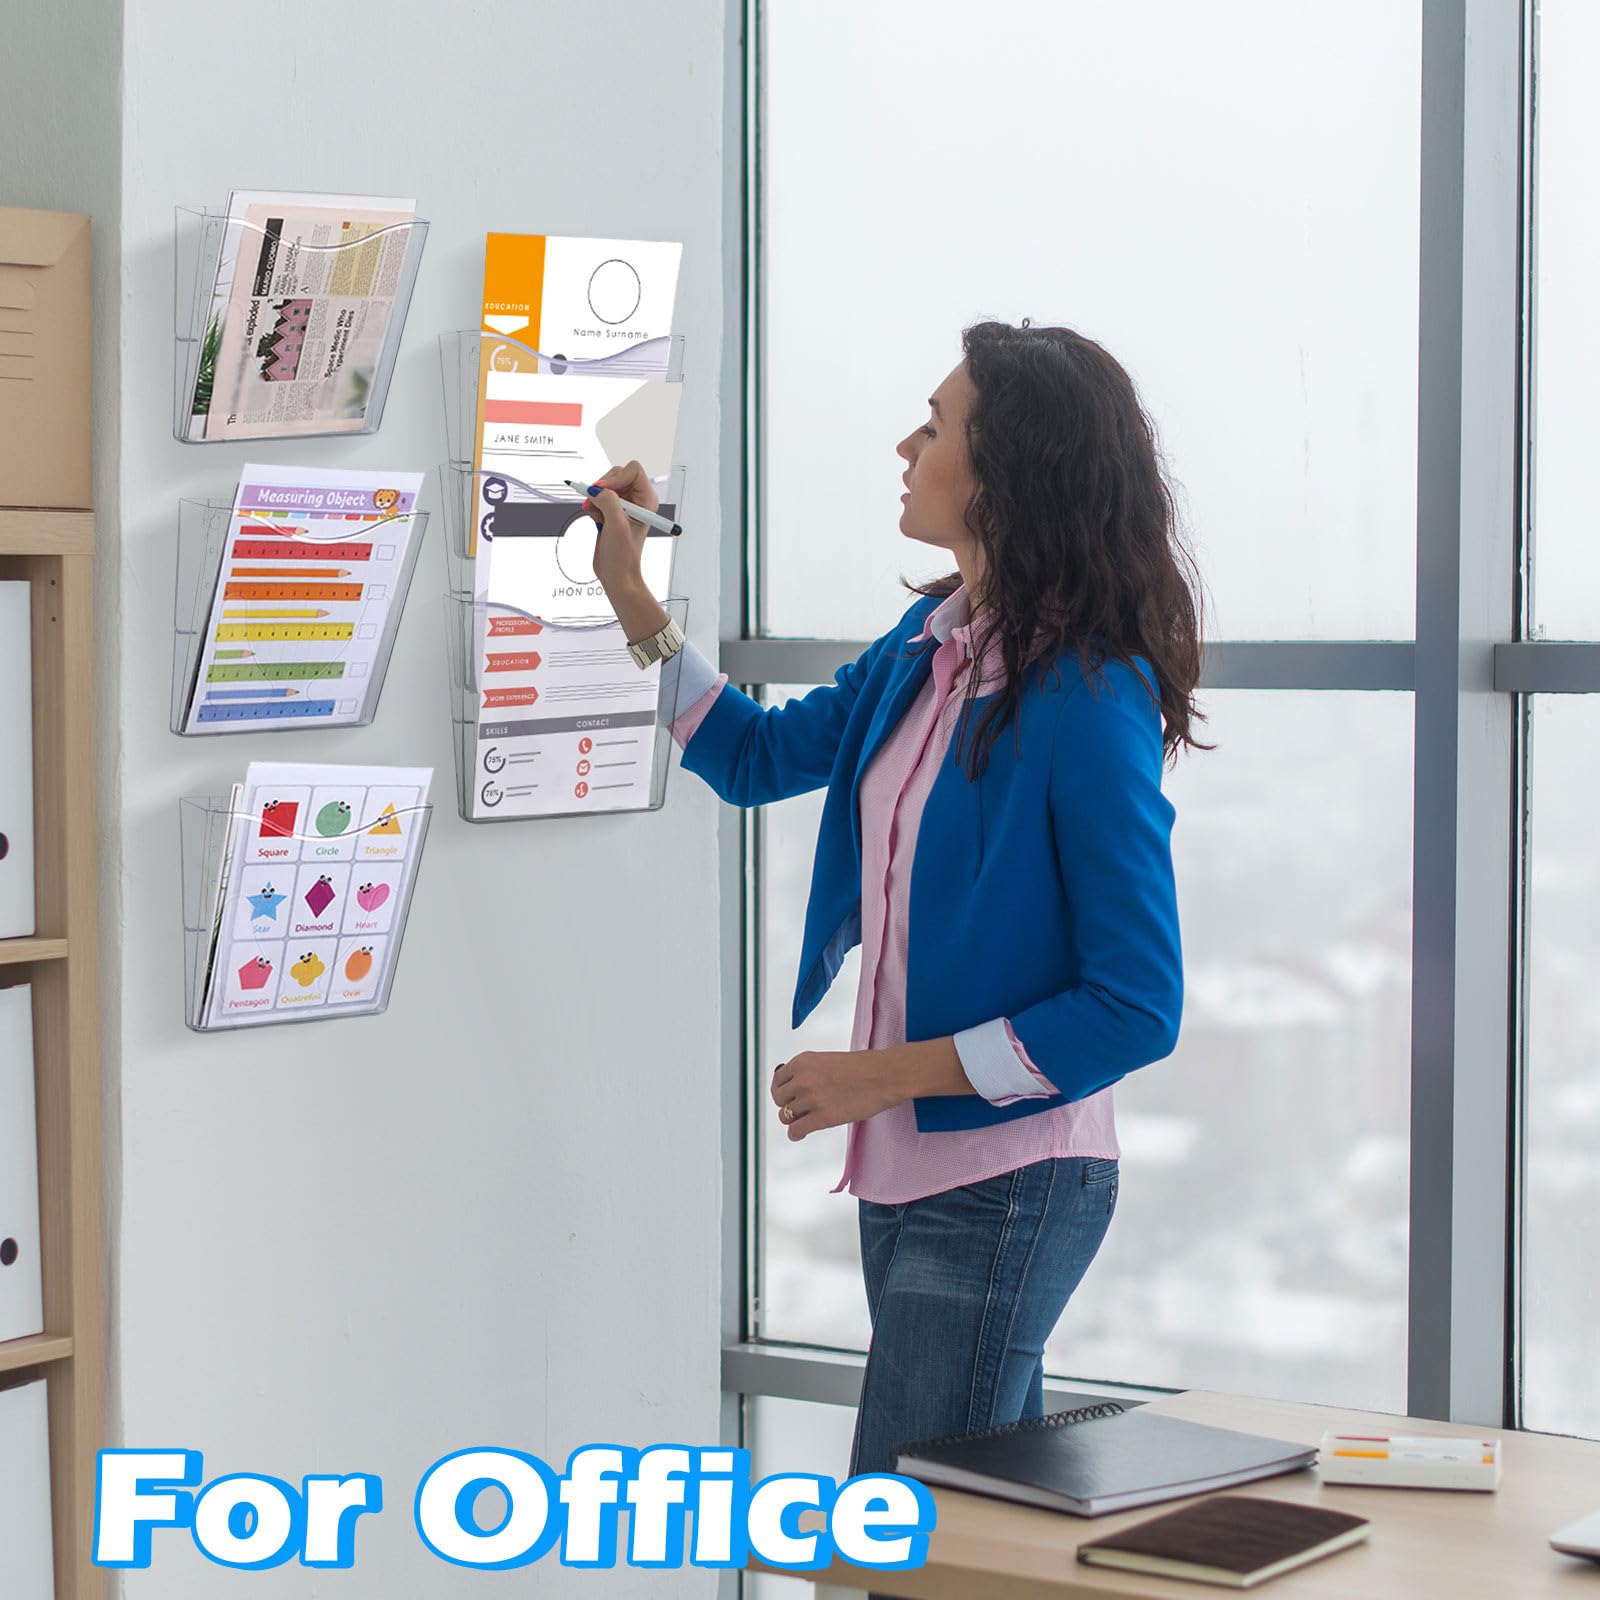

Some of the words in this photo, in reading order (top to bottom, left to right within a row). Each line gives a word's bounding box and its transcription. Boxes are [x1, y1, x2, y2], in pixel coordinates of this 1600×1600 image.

[266, 240, 278, 270] CUOMO
[261, 270, 272, 295] MARIO
[485, 302, 530, 312] EDUCATION
[246, 300, 260, 336] exploded
[336, 309, 347, 328] Who
[344, 310, 355, 328] Dies
[572, 328, 602, 338] Name
[605, 330, 649, 340] Surname
[330, 328, 343, 352] Medic
[324, 353, 336, 377] Space
[493, 434, 520, 444] JANE
[524, 435, 555, 446] SMITH
[257, 489, 324, 508] Measuring
[326, 491, 367, 507] Object
[552, 586, 583, 598] JHON
[492, 658, 530, 667] EDUCATION
[576, 718, 610, 729] CONTACT
[485, 726, 509, 736] SKILLS
[257, 848, 289, 858] Square
[315, 846, 340, 856] Circle
[364, 846, 398, 857] Triangle
[252, 925, 271, 934] Star
[295, 922, 334, 933] Diamond
[355, 920, 378, 929] Heart
[229, 998, 270, 1009] Pentagon
